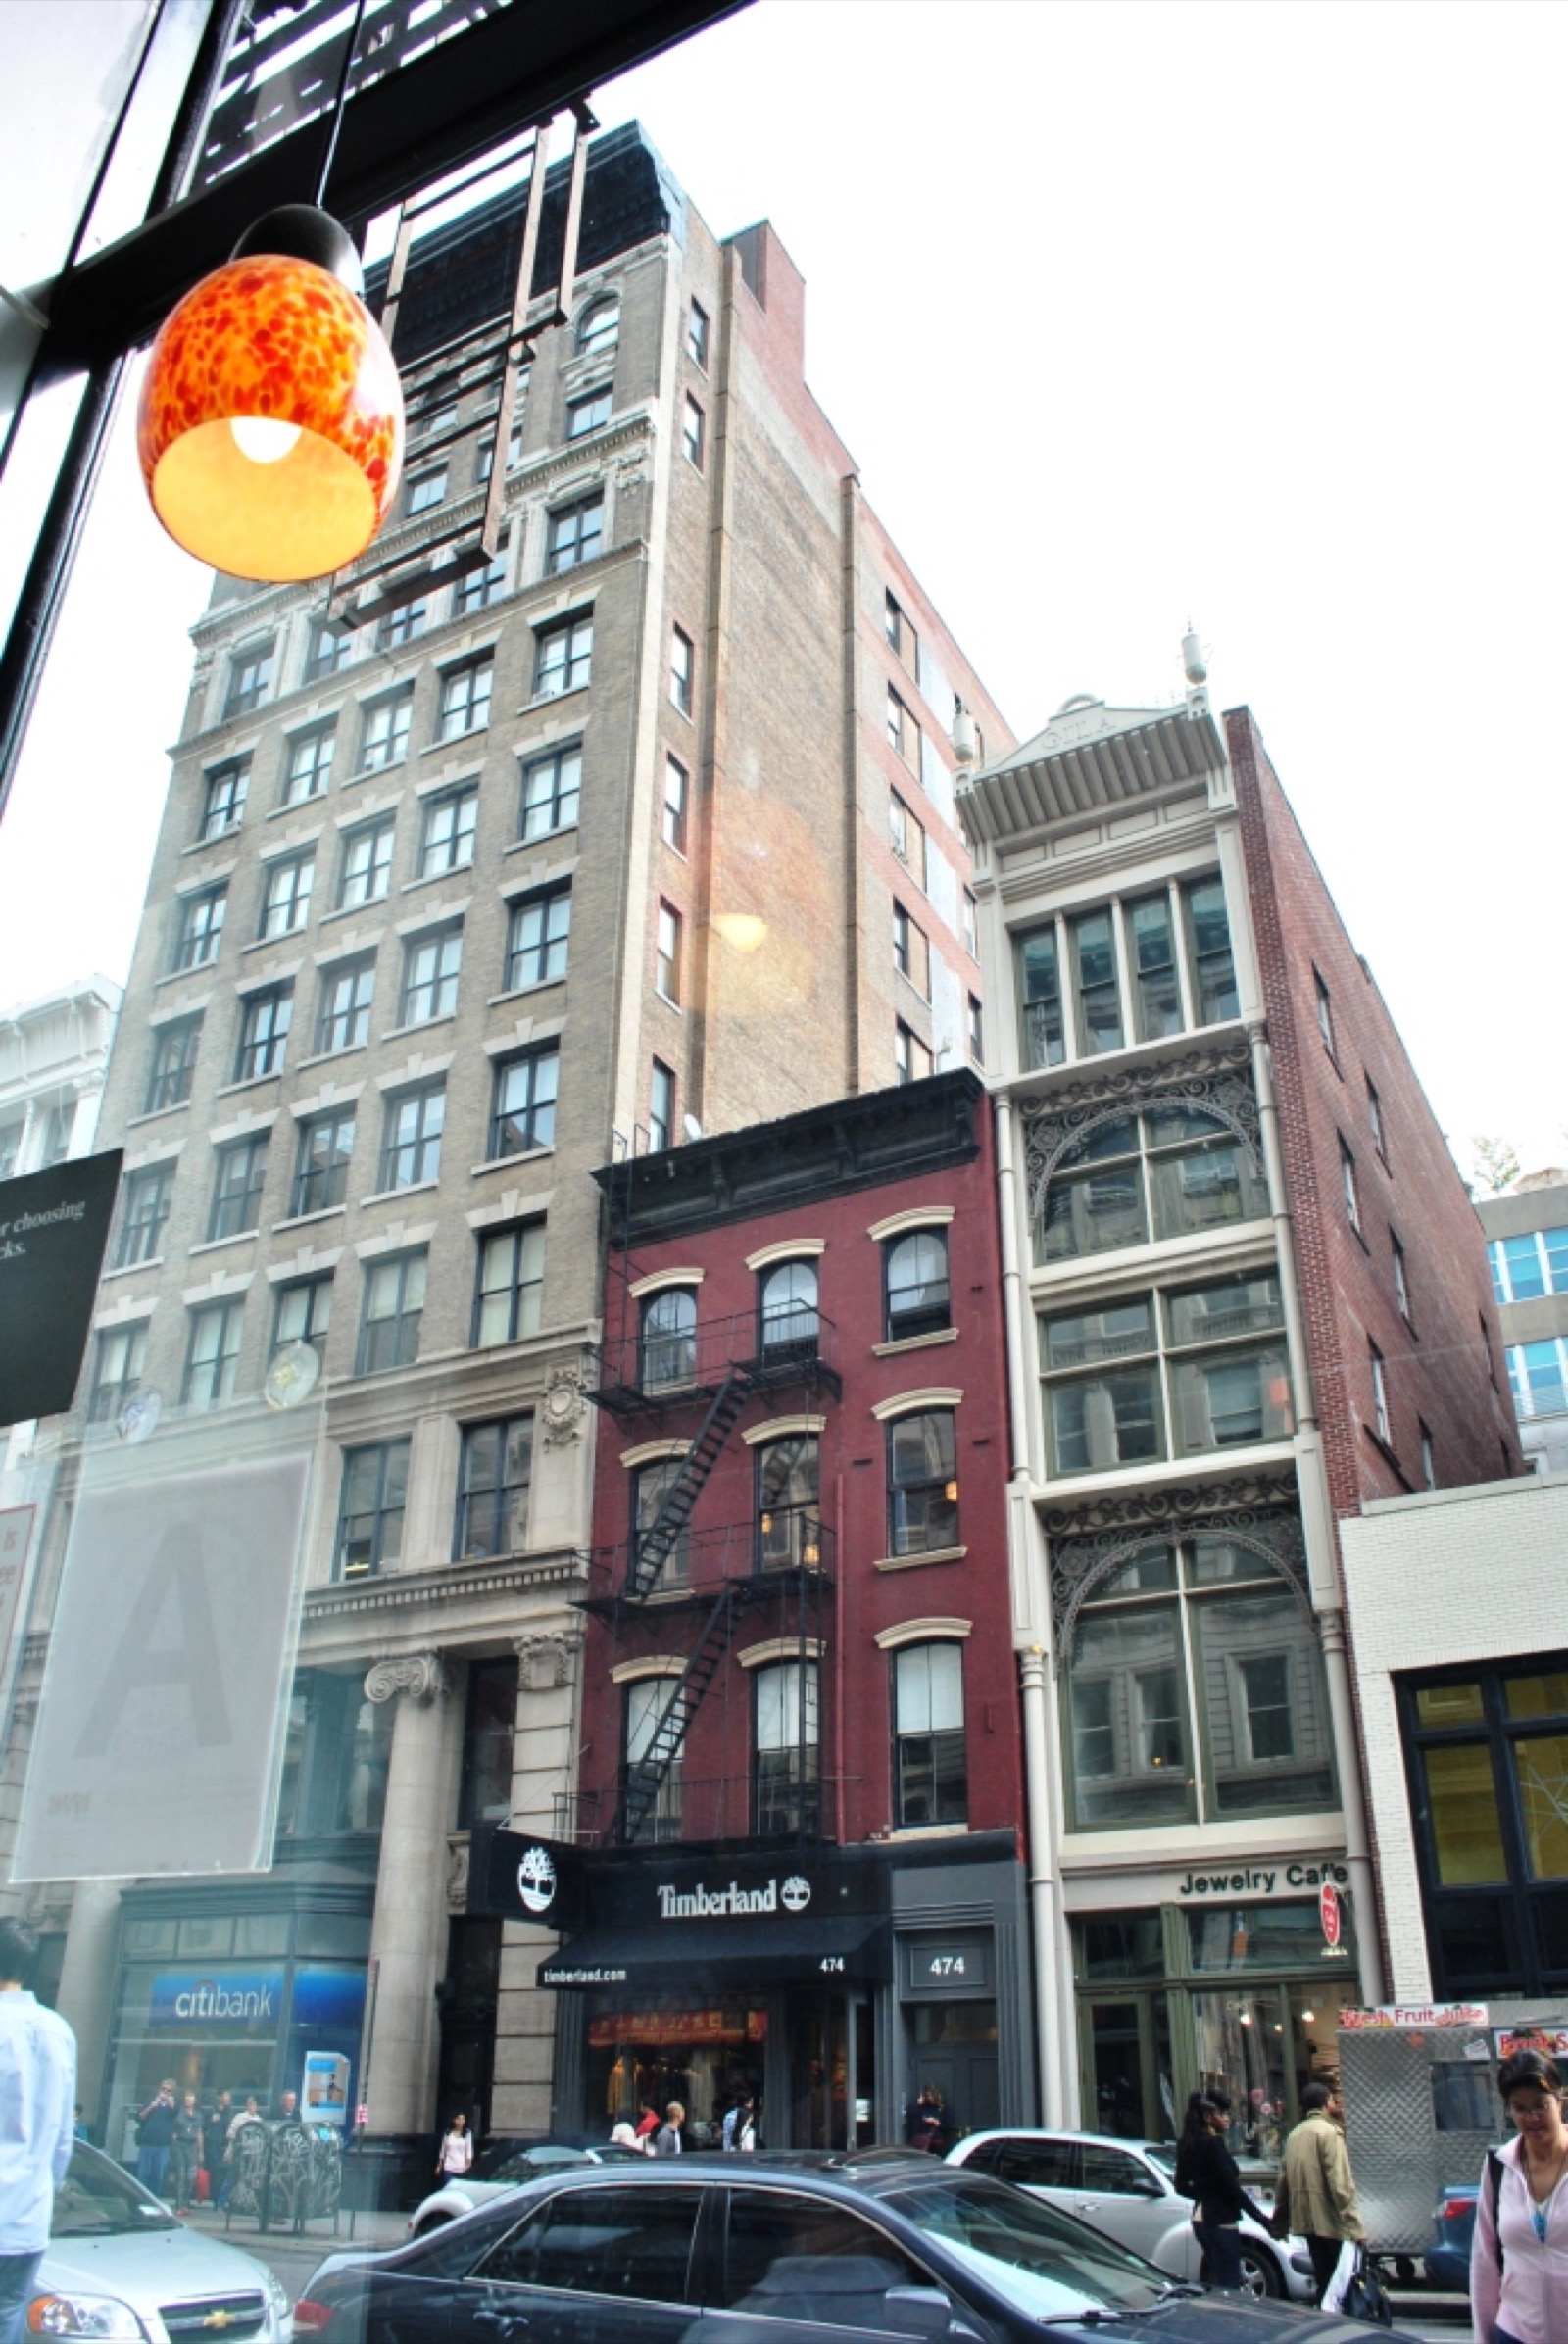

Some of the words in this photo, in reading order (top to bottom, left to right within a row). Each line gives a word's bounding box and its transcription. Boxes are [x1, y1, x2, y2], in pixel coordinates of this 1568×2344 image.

[13, 1201, 85, 1232] choosing
[73, 1522, 233, 1759] A
[1180, 1870, 1275, 1893] Jewelry
[657, 1878, 777, 1919] Timberland
[544, 1968, 626, 1982] timberland.com
[819, 1957, 845, 1972] 474
[929, 1956, 965, 1975] 474
[175, 1983, 272, 2018] citibank
[1395, 2008, 1435, 2023] Fruit
